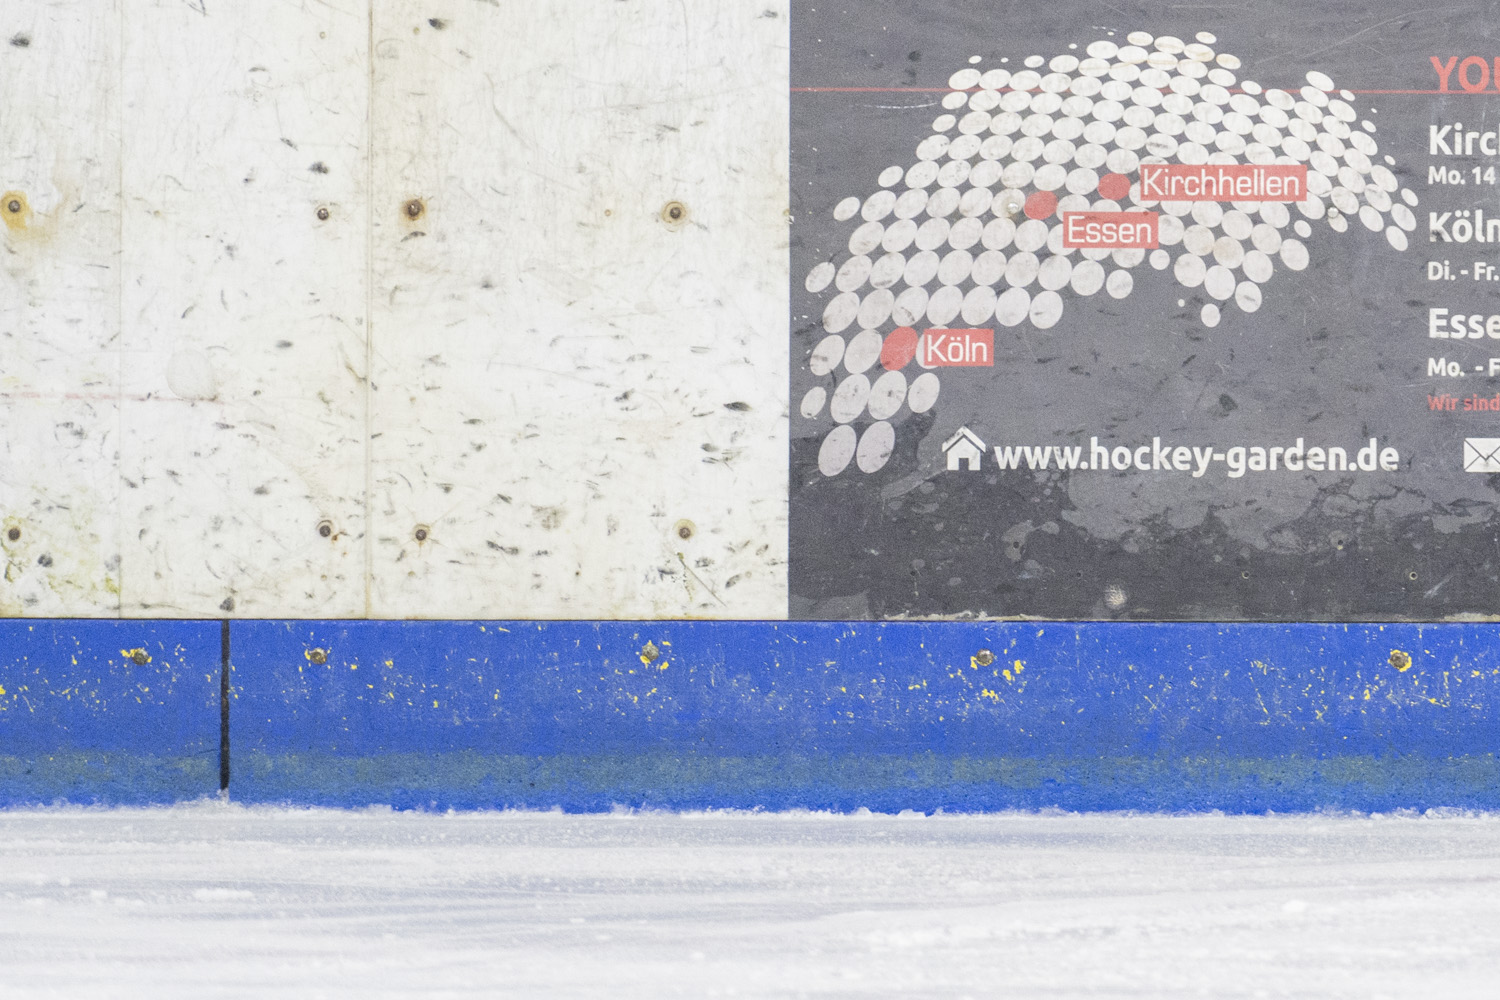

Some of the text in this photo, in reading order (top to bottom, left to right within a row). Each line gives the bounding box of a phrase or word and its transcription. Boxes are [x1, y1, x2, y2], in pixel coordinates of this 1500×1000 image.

[1143, 168, 1300, 198] Kirchhellen
[1428, 166, 1466, 185] Mo.
[1472, 166, 1496, 185] 14
[1068, 216, 1153, 244] Essen
[1427, 260, 1456, 281] Di.
[1474, 262, 1499, 281] Fr.
[927, 332, 987, 363] Köln
[1427, 357, 1465, 377] Mo.
[1427, 394, 1458, 411] Wir
[1463, 394, 1500, 412] sind
[993, 437, 1401, 478] www.hockey-garden.de
